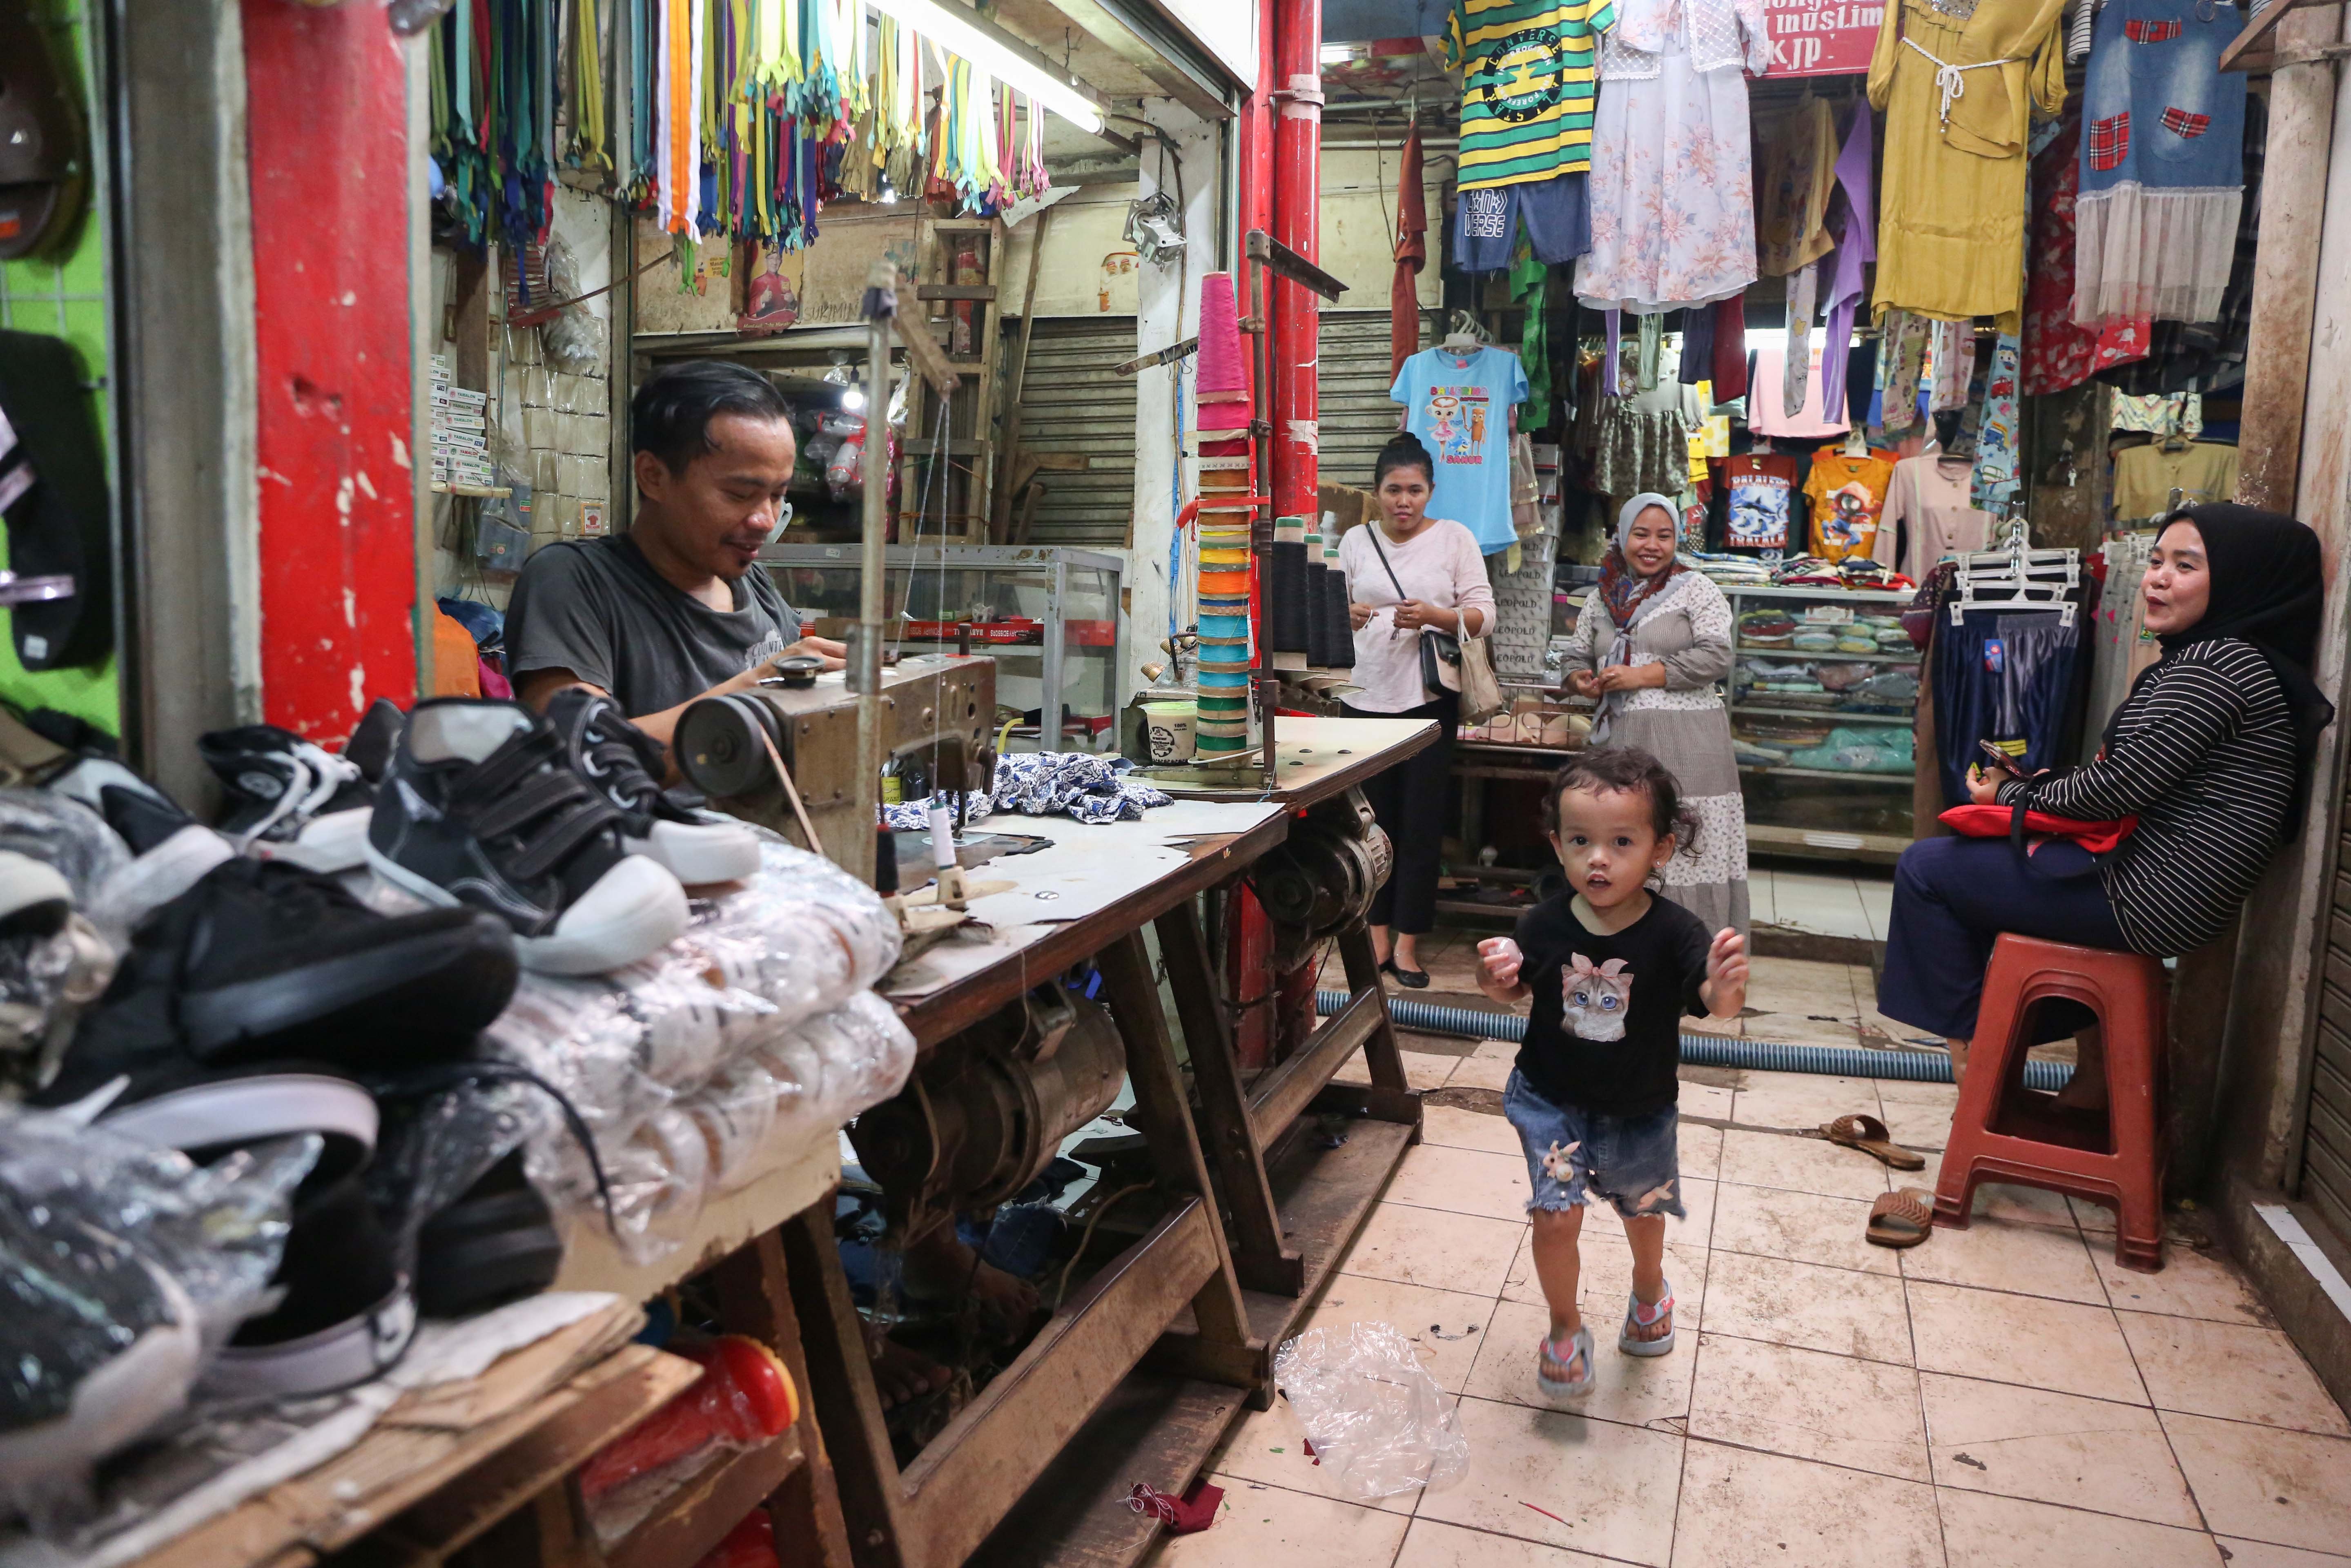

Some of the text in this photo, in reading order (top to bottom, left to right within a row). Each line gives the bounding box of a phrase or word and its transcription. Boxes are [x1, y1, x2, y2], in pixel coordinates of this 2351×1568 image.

[1776, 5, 1884, 33] muslim
[1489, 29, 1561, 65] CONVERSE
[1465, 214, 1505, 237] VERSE
[1446, 455, 1482, 464] SAHUR
[1496, 654, 1533, 664] EOPOLD
